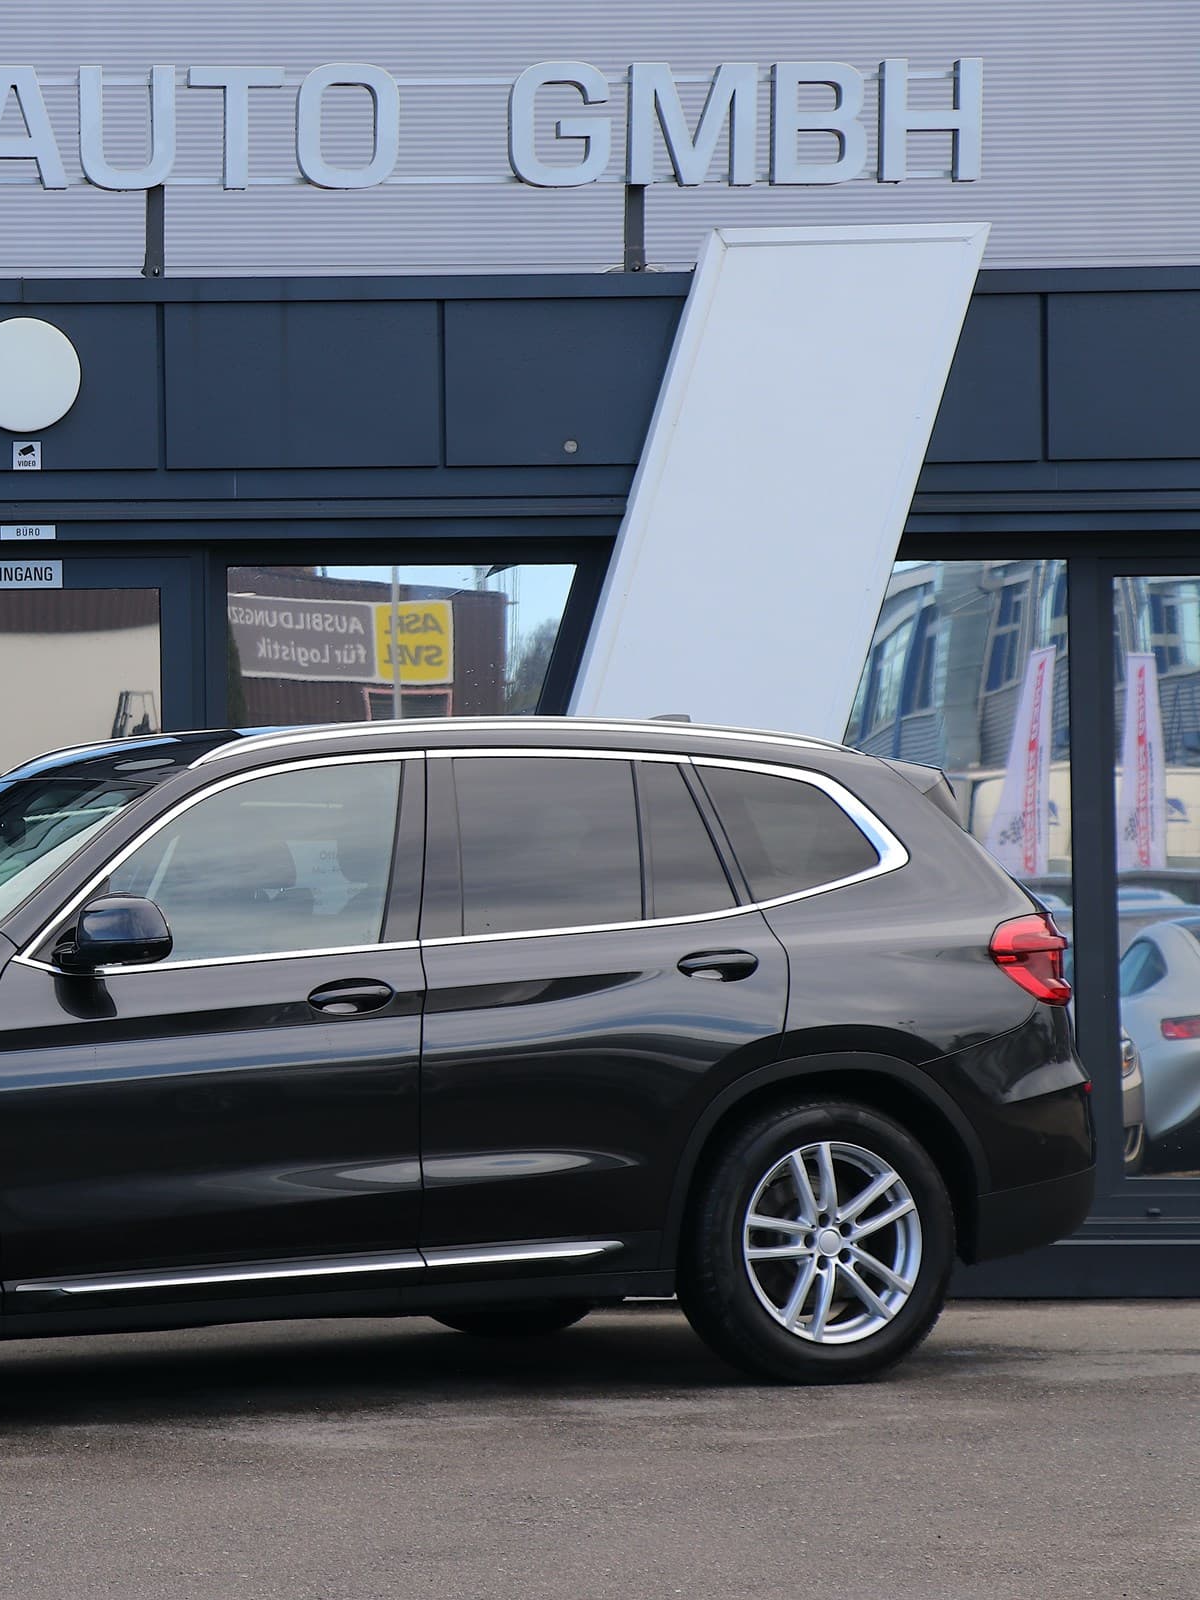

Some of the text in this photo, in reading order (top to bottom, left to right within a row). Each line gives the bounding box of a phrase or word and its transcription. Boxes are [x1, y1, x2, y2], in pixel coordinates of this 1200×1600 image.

[507, 57, 983, 189] GMBH
[17, 460, 37, 468] VIDEO
[16, 527, 40, 537] BÜRO
